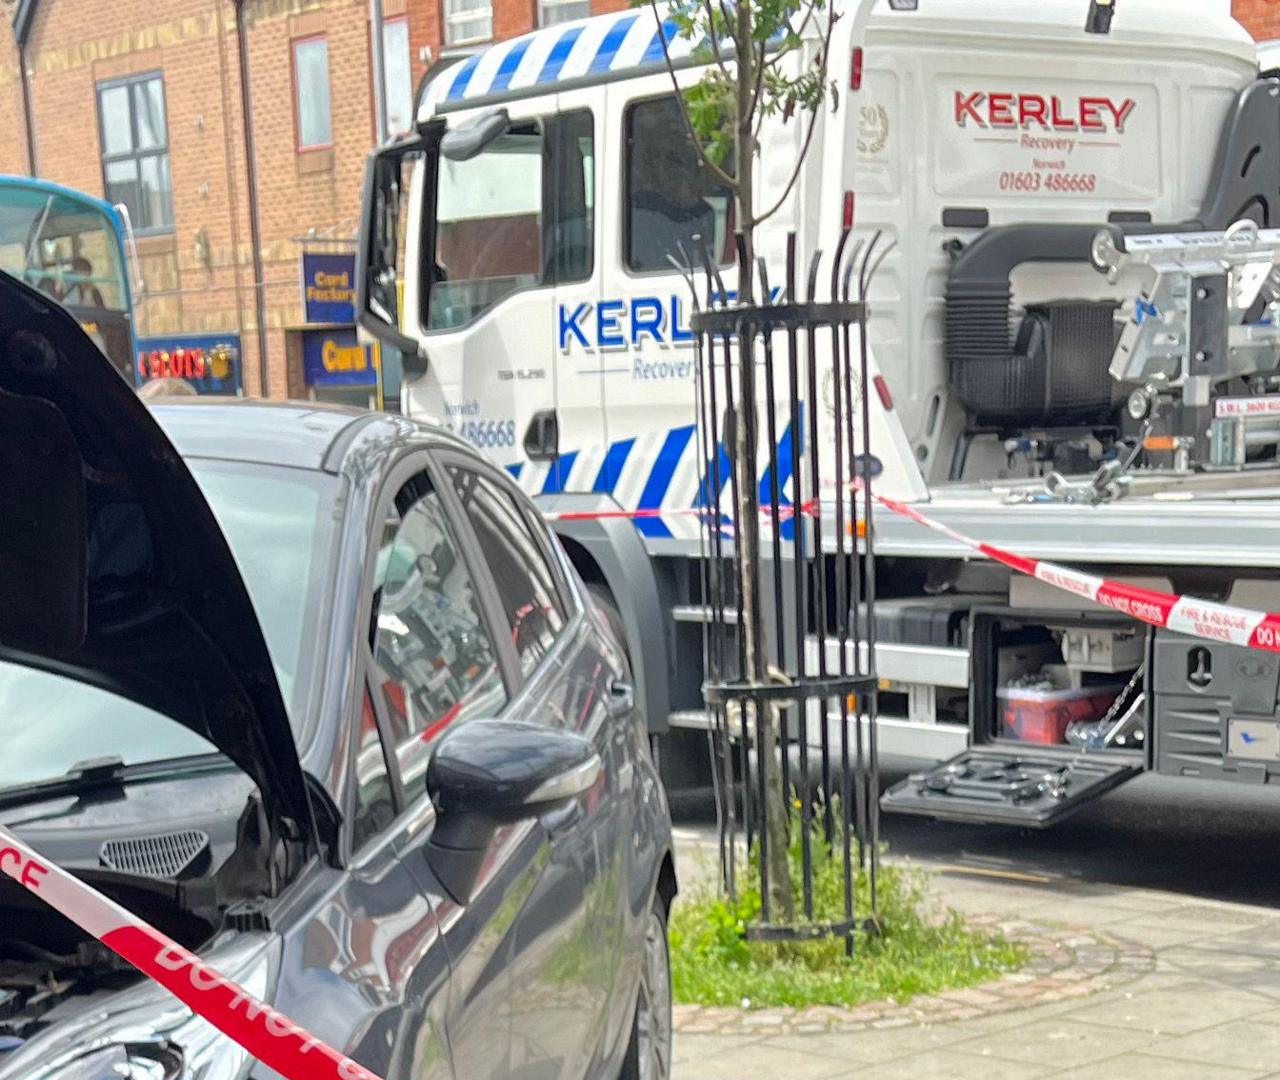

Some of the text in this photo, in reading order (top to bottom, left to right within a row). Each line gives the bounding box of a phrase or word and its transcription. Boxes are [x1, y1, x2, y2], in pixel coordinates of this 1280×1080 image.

[954, 90, 1136, 134] KERLEY
[1020, 133, 1075, 152] Recovery
[999, 172, 1096, 193] 01603 486668
[315, 271, 349, 287] Card
[322, 340, 367, 373] Card
[1256, 627, 1272, 646] DO
